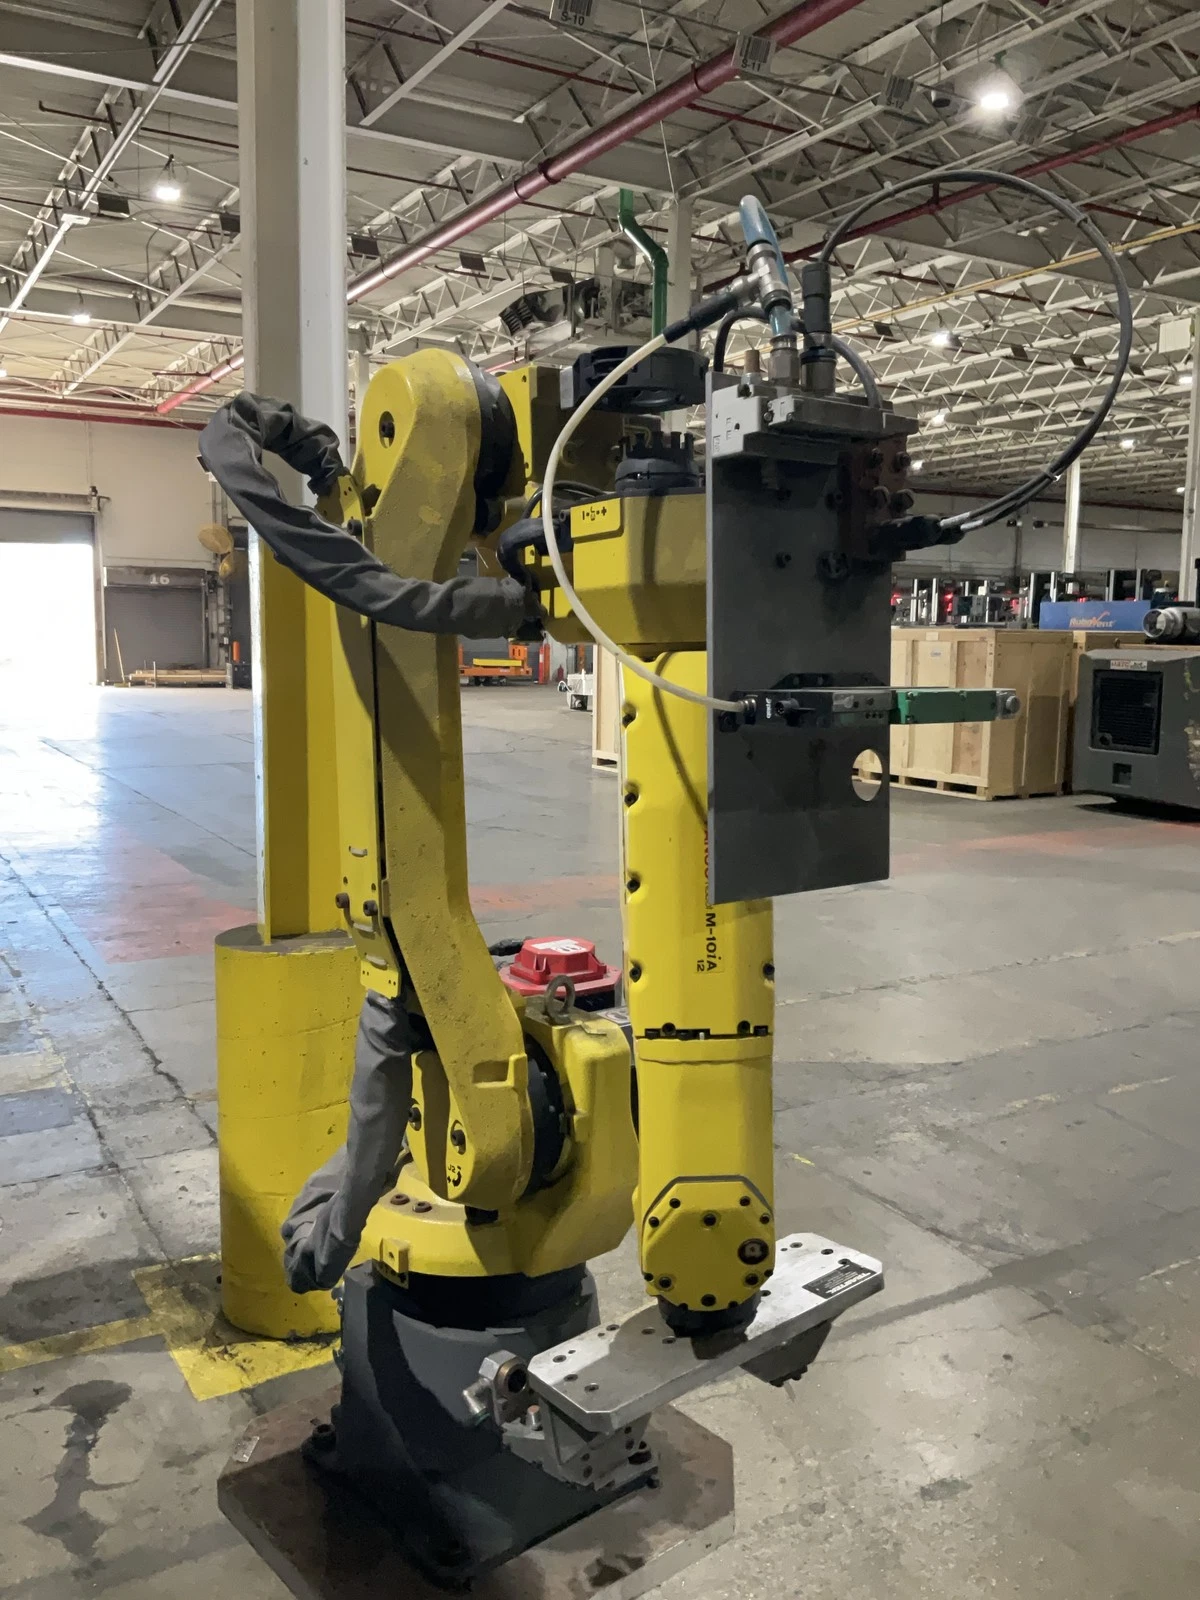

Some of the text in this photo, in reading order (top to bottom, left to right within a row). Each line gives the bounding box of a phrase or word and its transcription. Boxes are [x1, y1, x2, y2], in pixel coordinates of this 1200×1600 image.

[561, 11, 585, 26] S-10
[741, 58, 761, 72] S-11
[150, 573, 170, 585] 16
